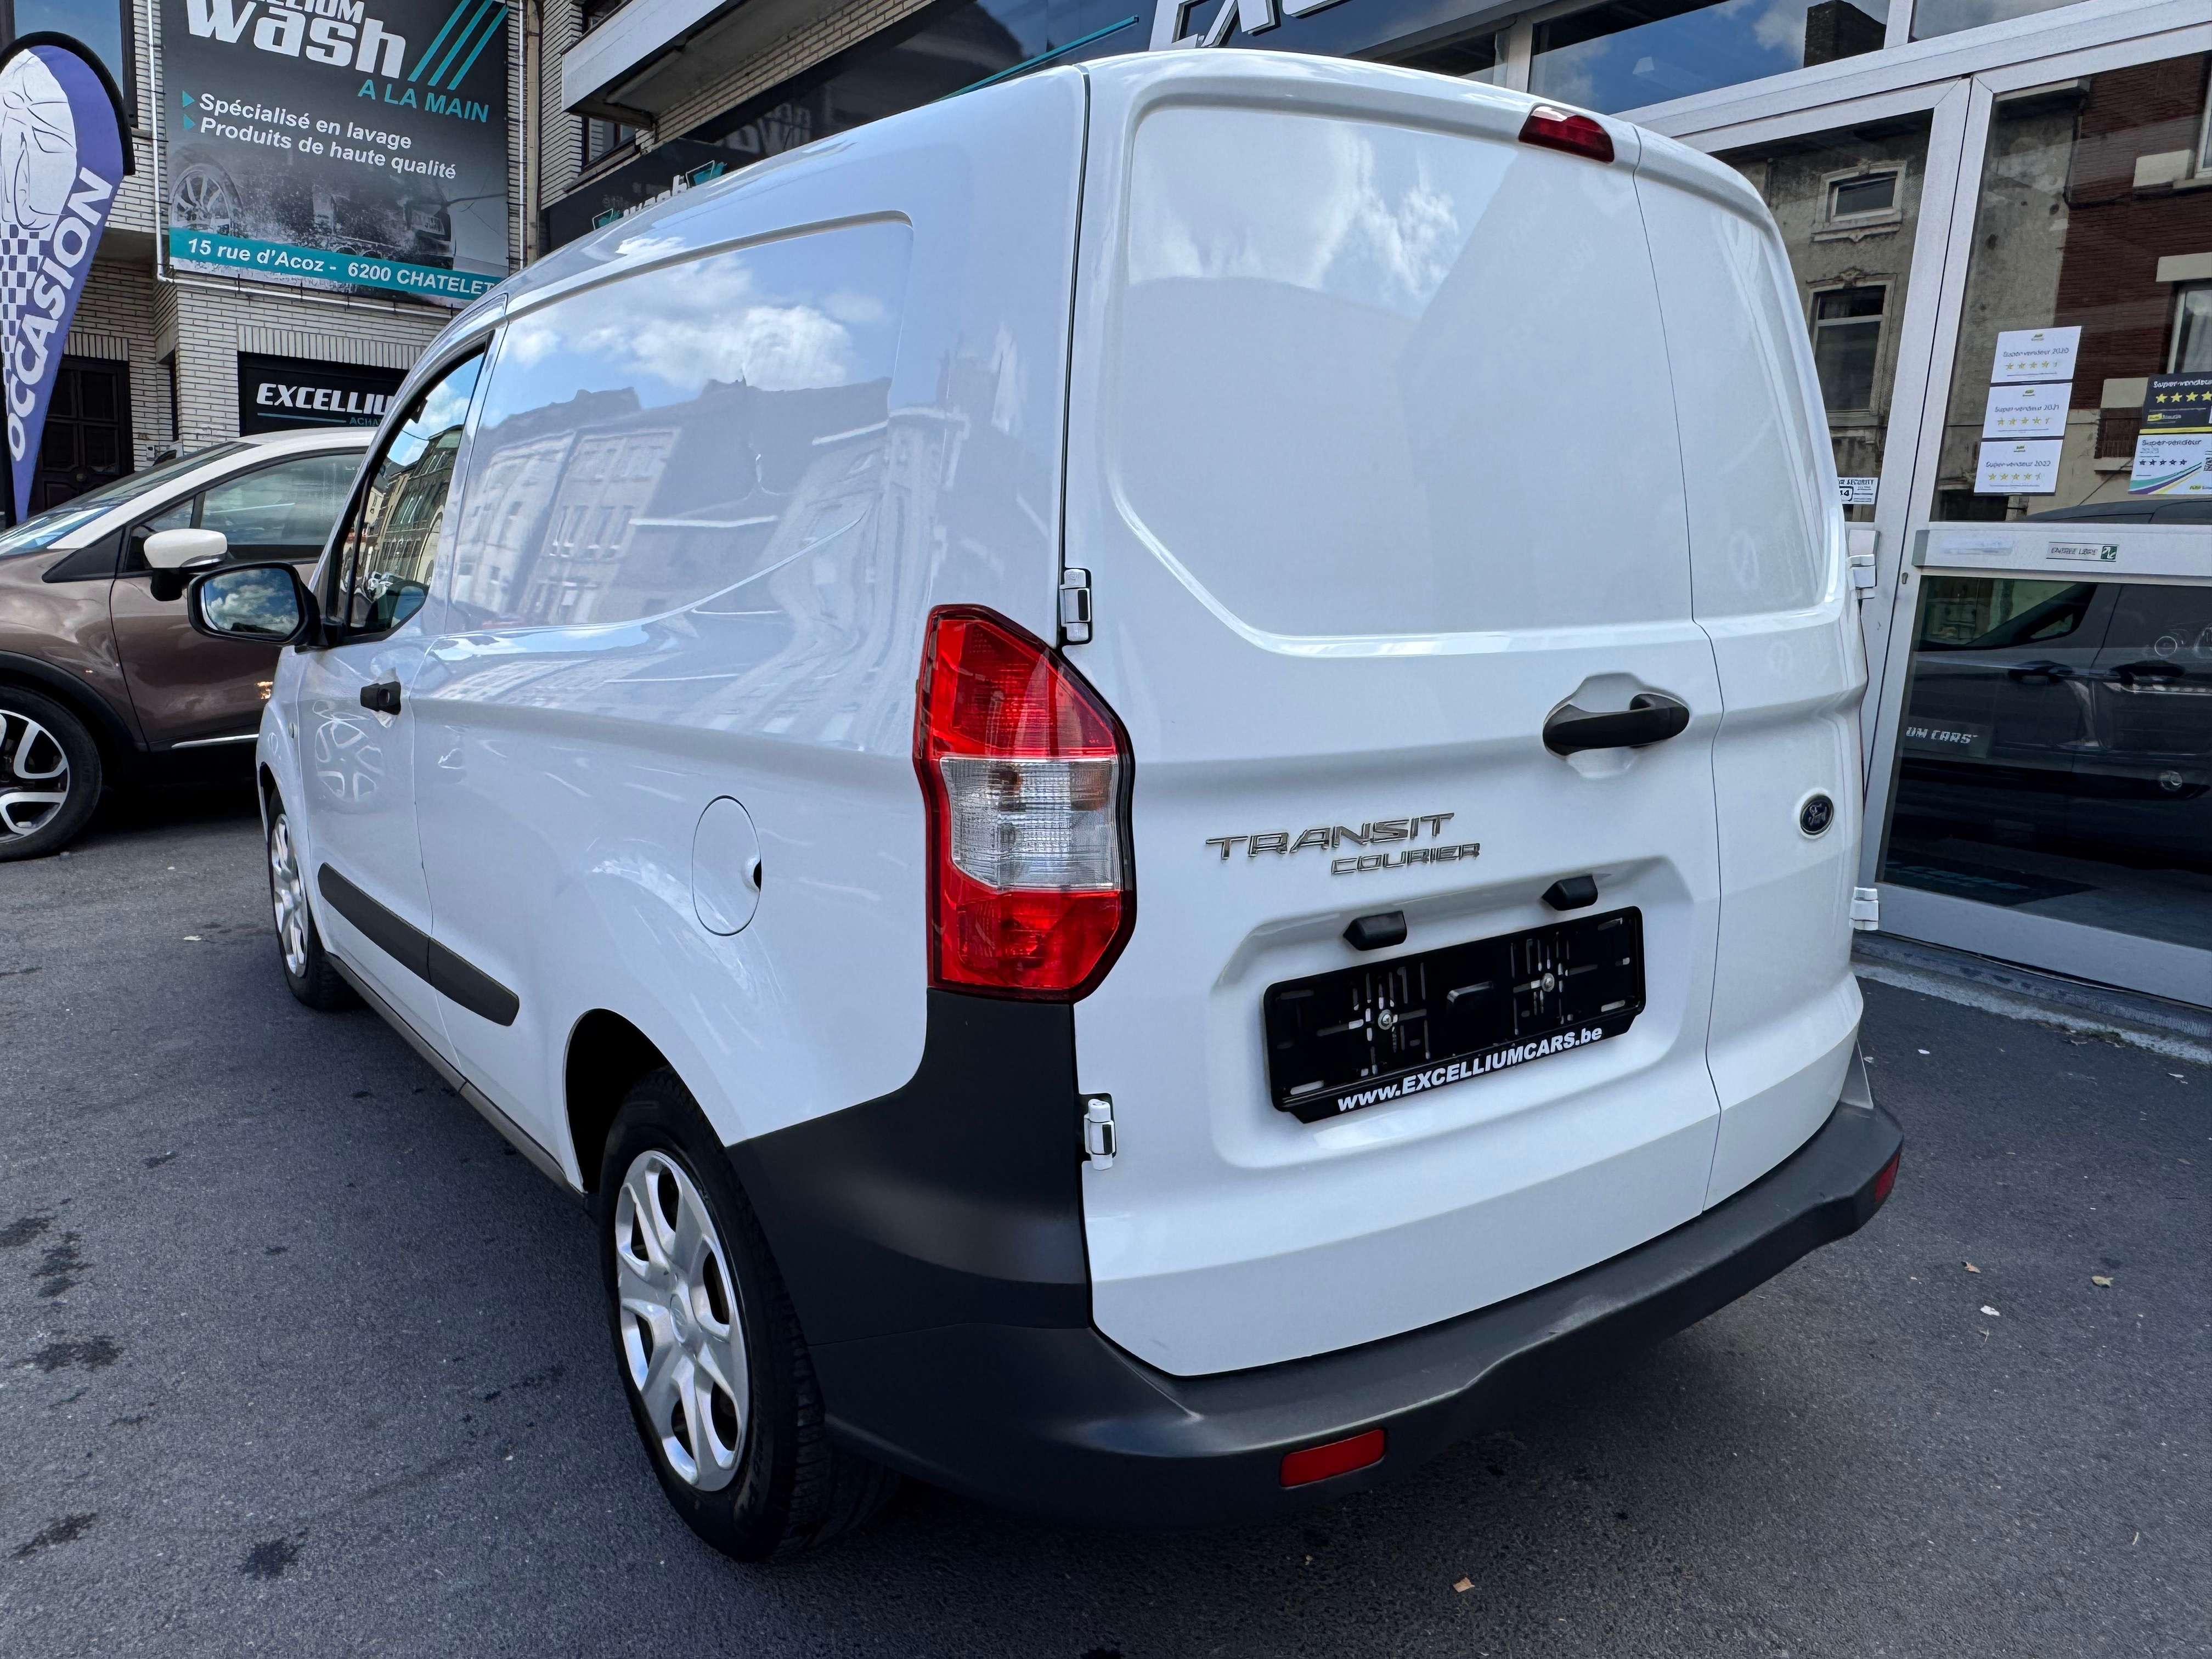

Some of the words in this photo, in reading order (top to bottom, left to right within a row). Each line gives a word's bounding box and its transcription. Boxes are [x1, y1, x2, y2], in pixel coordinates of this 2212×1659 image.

[199, 93, 310, 129] Spécialisé
[316, 120, 340, 136] en
[347, 122, 411, 150] lavage
[358, 79, 376, 100] A
[384, 83, 417, 109] LA
[425, 92, 489, 122] MAIN
[201, 117, 292, 149] Produits
[298, 136, 324, 154] de
[329, 141, 386, 166] haute
[391, 156, 456, 179] qualité
[189, 238, 211, 255] 15
[217, 245, 251, 261] rue
[257, 249, 324, 272] d'Acoz
[348, 262, 391, 281] 6200
[8, 166, 113, 461] OCCASION
[256, 383, 394, 415] EXCELLIU
[349, 417, 382, 426] ACHA
[1205, 812, 1455, 861] TRANSIT
[1330, 843, 1481, 876] COURIER
[1337, 1026, 1603, 1112] www.EXCELLIUMCARS.be
